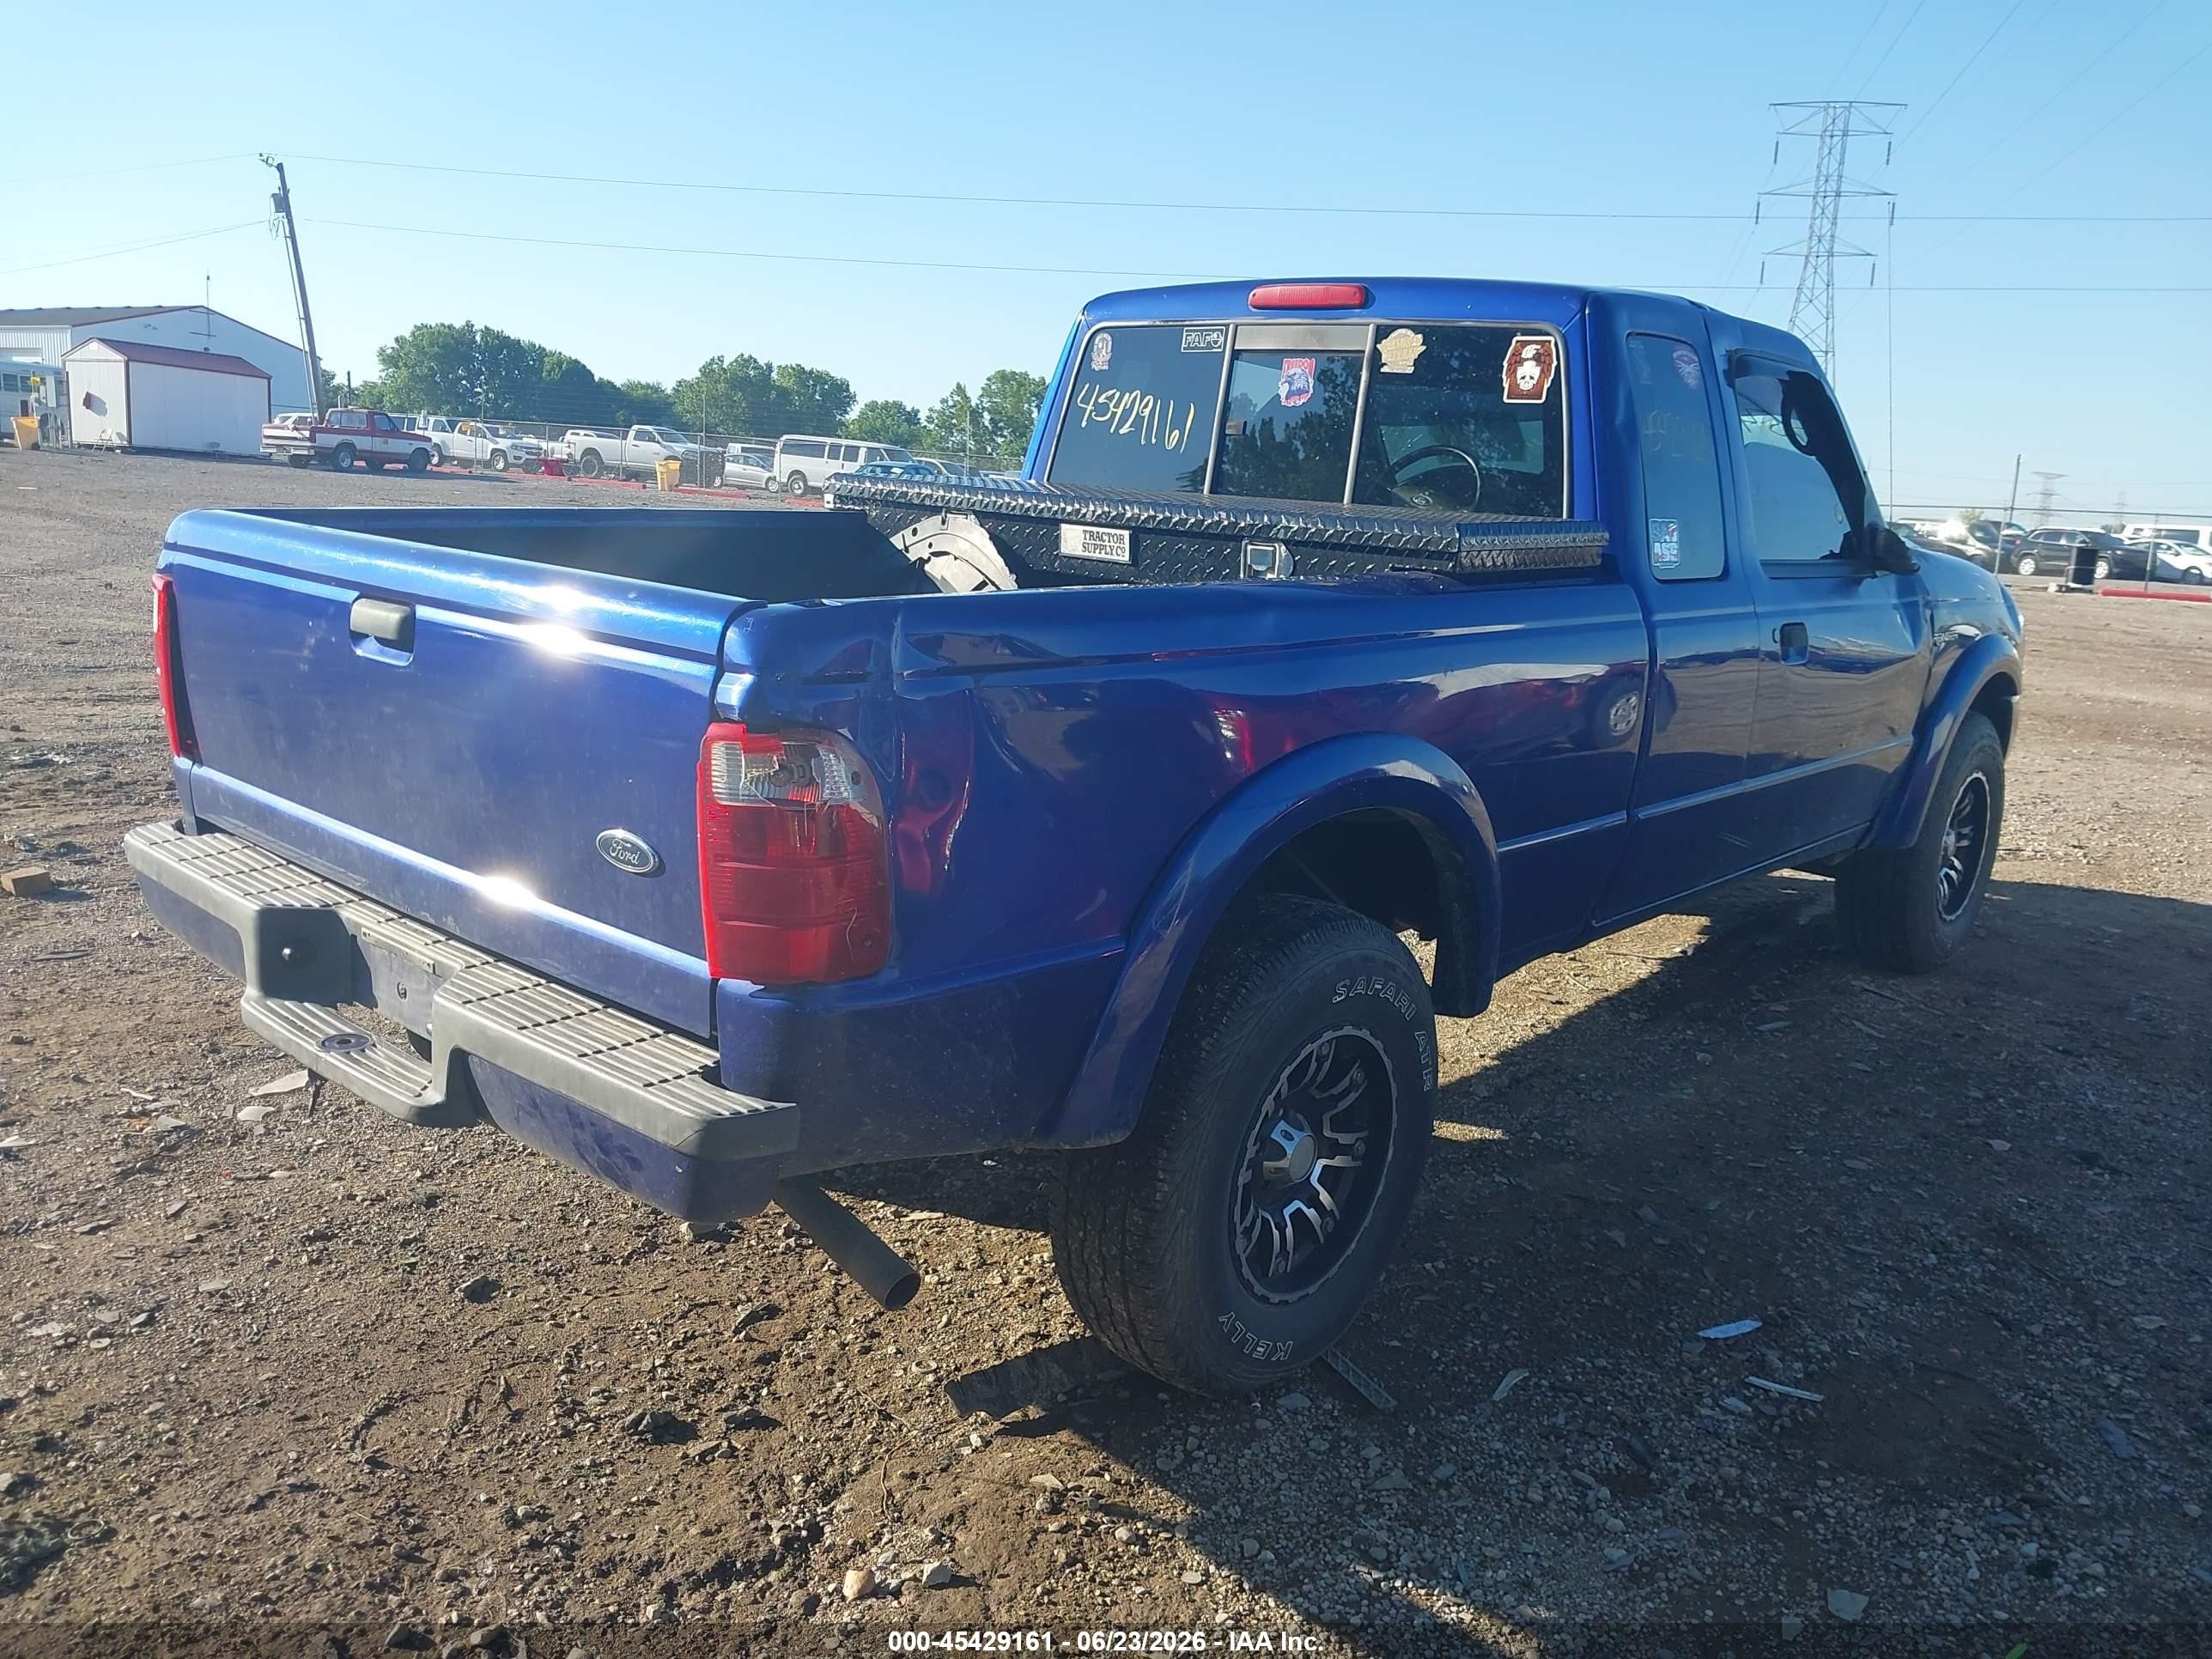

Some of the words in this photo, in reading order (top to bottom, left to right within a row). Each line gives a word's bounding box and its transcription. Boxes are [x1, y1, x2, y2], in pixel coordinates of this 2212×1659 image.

[1077, 383, 1194, 453] 45429161
[1082, 529, 1125, 545] TRACTOR
[1082, 542, 1115, 556] SUPPLY
[610, 838, 641, 865] Ford
[1333, 976, 1417, 1021] SAFARI
[1218, 1311, 1293, 1360] KELLY
